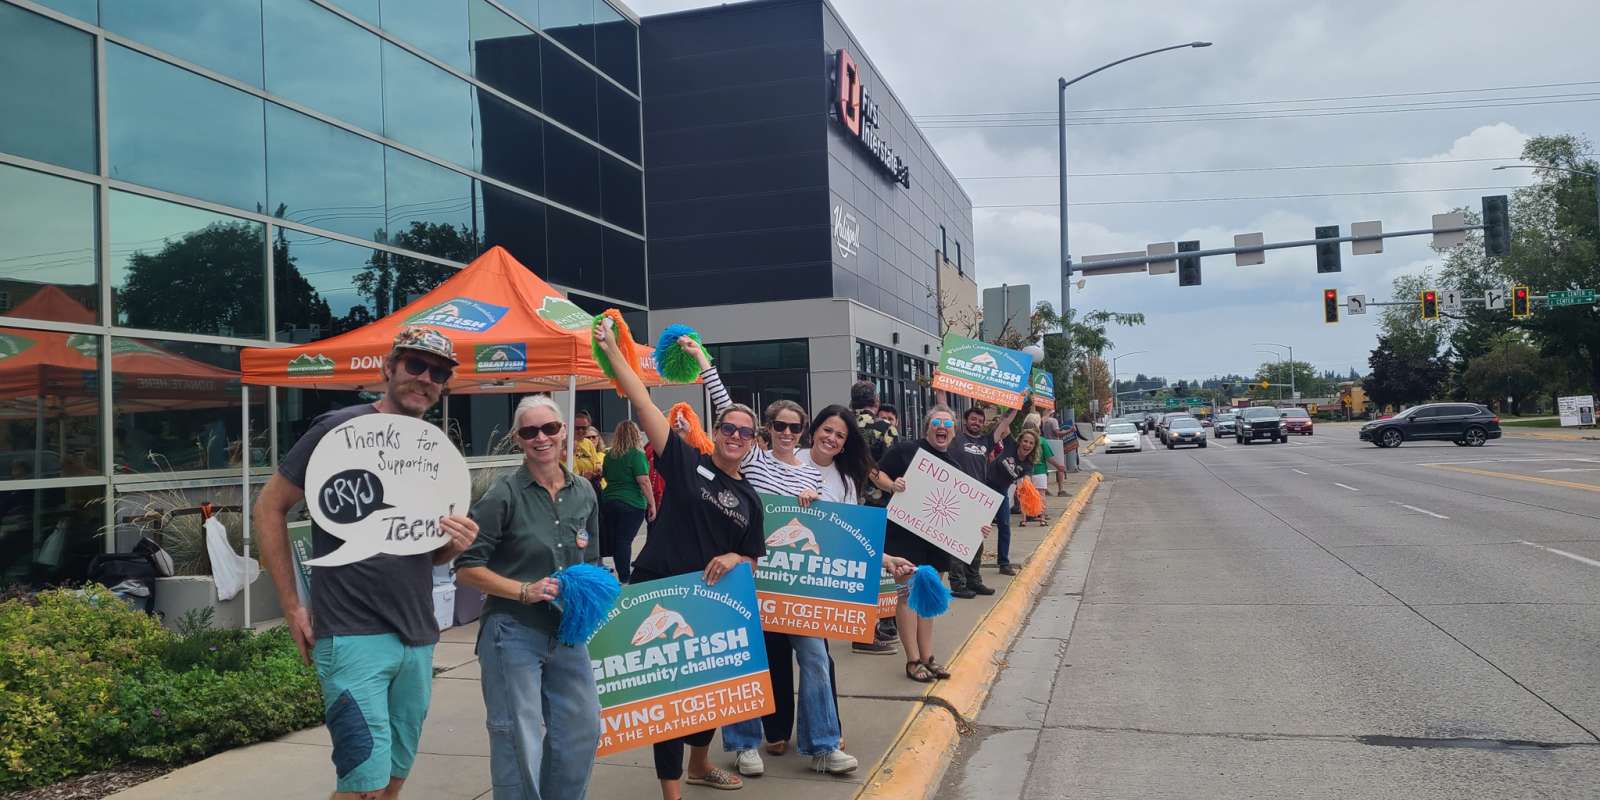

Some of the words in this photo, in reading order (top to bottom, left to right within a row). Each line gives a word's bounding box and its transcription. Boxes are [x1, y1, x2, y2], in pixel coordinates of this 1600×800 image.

[862, 87, 880, 130] First
[862, 115, 898, 175] Interstate
[350, 356, 383, 370] DON
[947, 357, 991, 374] GREAT
[938, 375, 974, 390] GIVING
[335, 423, 401, 450] Thanks
[416, 429, 438, 452] for
[377, 450, 440, 480] Supporting
[917, 457, 950, 483] END
[952, 477, 995, 509] YOUTH
[324, 473, 374, 518] CRYJ
[765, 503, 828, 521] Community
[829, 512, 877, 558] Foundation
[888, 504, 971, 557] HOMELESSNESS
[757, 550, 805, 571] EAT
[621, 585, 691, 610] Community
[693, 584, 753, 620] Foundation
[799, 574, 865, 594] challenge
[782, 601, 867, 625] TOGETHER
[823, 622, 867, 636] VALLEY
[596, 665, 679, 695] ommunity
[680, 651, 751, 675] challenge
[600, 703, 666, 735] IVING
[670, 681, 764, 714] TOGETHER
[617, 727, 644, 744] THE
[648, 710, 718, 736] FLATHEAD
[720, 698, 766, 717] VALLEY
